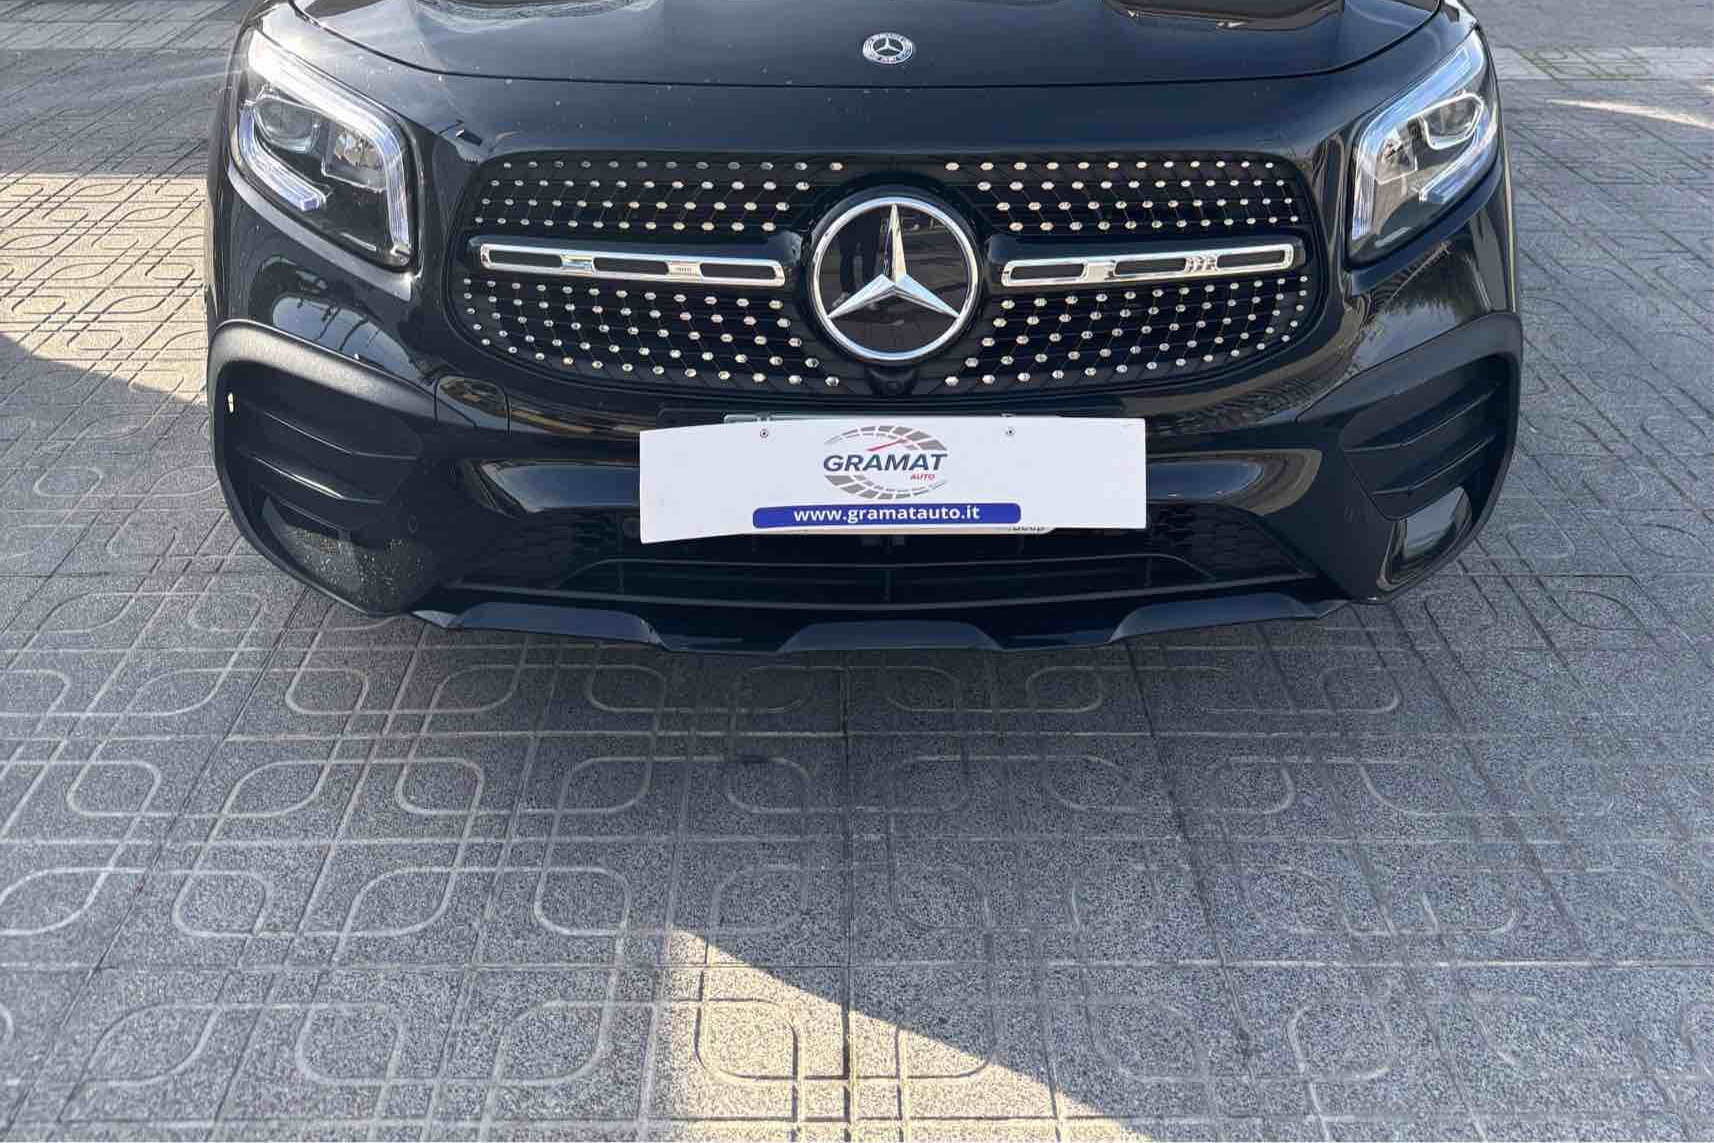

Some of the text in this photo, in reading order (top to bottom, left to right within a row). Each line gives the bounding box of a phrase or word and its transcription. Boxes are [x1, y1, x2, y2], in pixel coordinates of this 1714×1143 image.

[823, 452, 948, 472] GRAMAT
[910, 473, 936, 481] AUTO
[794, 504, 980, 523] www.gramatauto.it
